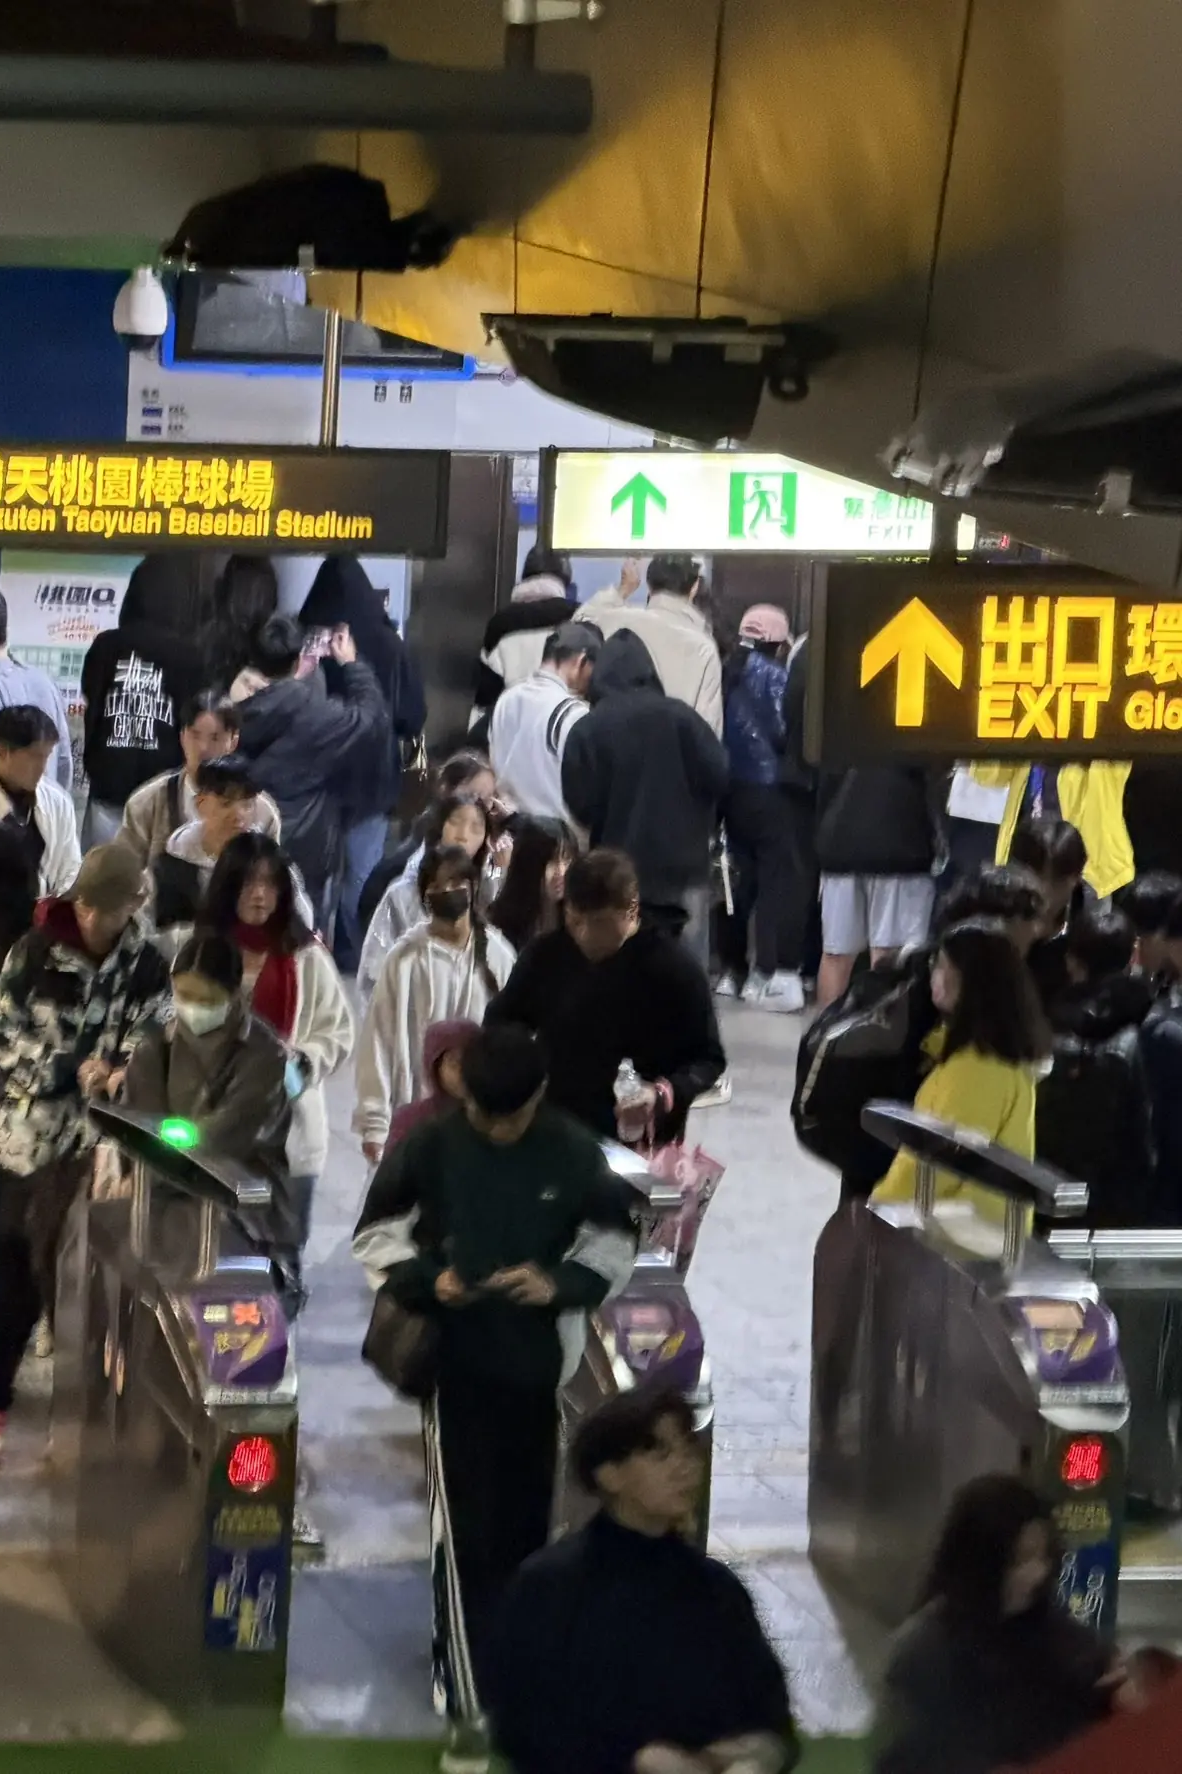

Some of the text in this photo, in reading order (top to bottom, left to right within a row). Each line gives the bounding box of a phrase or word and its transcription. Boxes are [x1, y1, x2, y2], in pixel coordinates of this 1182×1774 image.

[62, 505, 161, 539] Taoyuan
[168, 507, 269, 537] Baseball
[276, 510, 372, 540] Stadium
[868, 525, 914, 541] EXIT
[979, 595, 1116, 688] 出口
[977, 684, 1112, 738] EXIT
